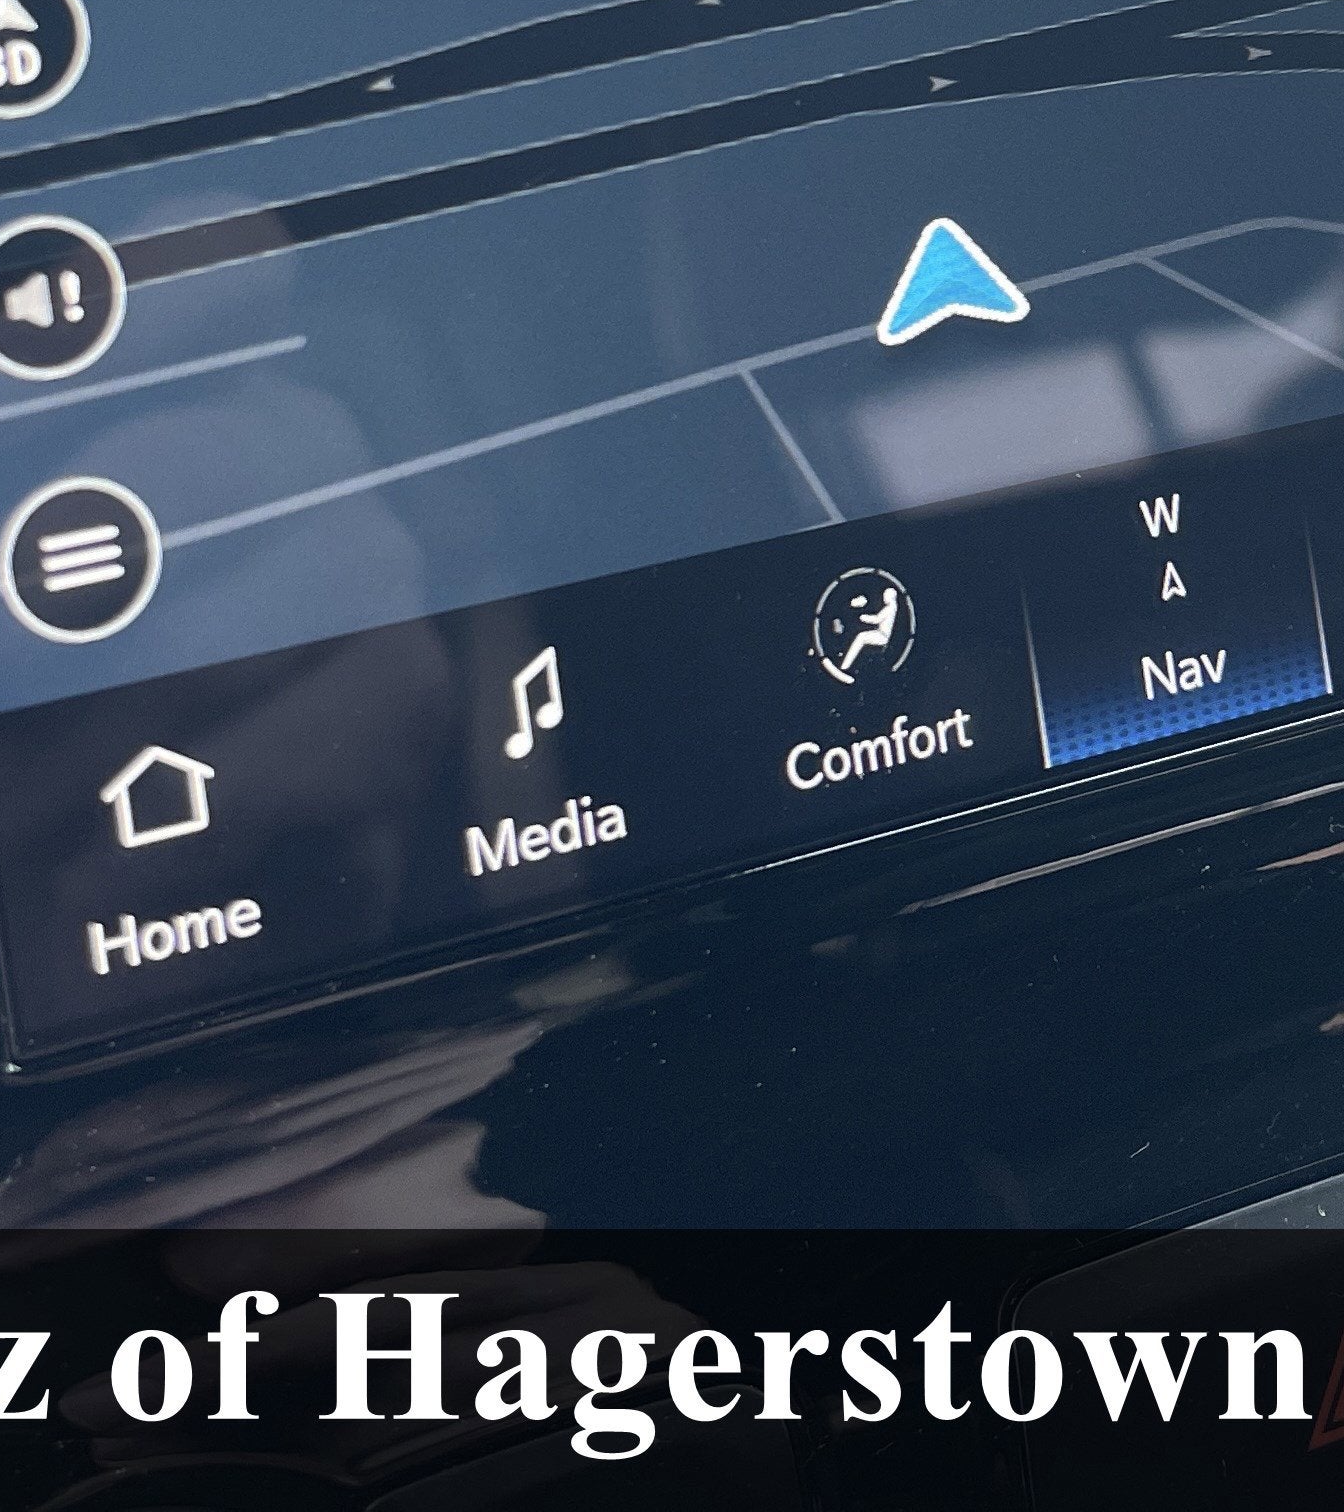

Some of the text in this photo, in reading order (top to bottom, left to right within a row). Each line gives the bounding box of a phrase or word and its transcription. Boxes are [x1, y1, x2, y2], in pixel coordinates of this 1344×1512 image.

[1139, 493, 1182, 537] W
[1141, 648, 1229, 700] Nav
[785, 707, 974, 792] Comfort
[464, 794, 629, 876] Media
[86, 896, 263, 975] Home
